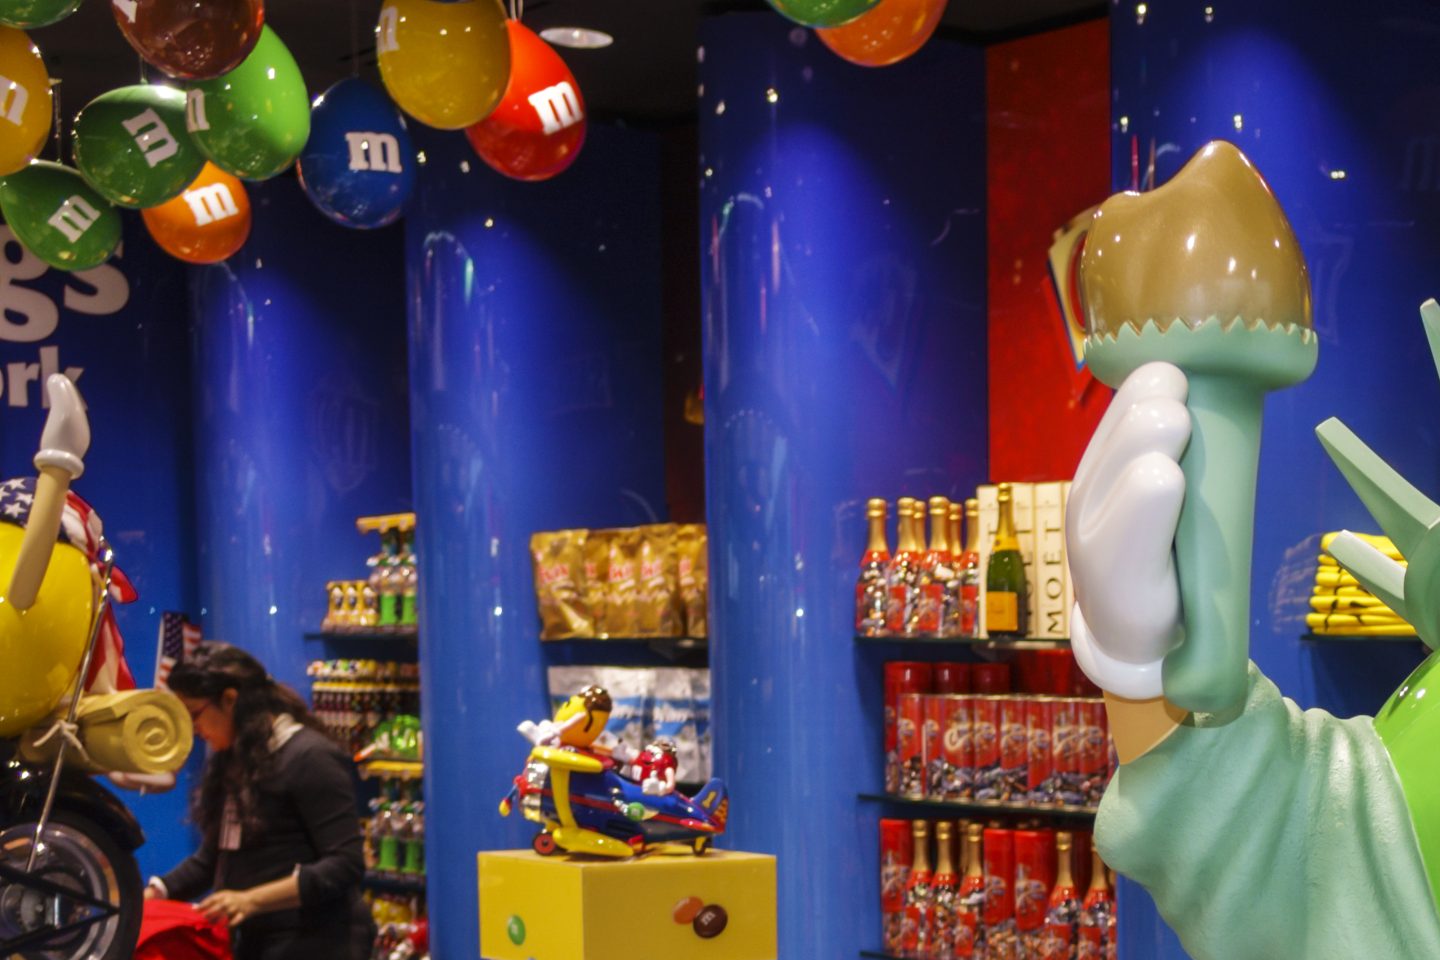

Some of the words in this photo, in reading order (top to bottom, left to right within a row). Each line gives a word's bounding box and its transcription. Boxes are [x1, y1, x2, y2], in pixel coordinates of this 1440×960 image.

[528, 81, 583, 135] m
[122, 108, 179, 168] m
[345, 131, 402, 173] m
[48, 195, 101, 243] m
[183, 182, 238, 226] m
[0, 346, 88, 409] rk
